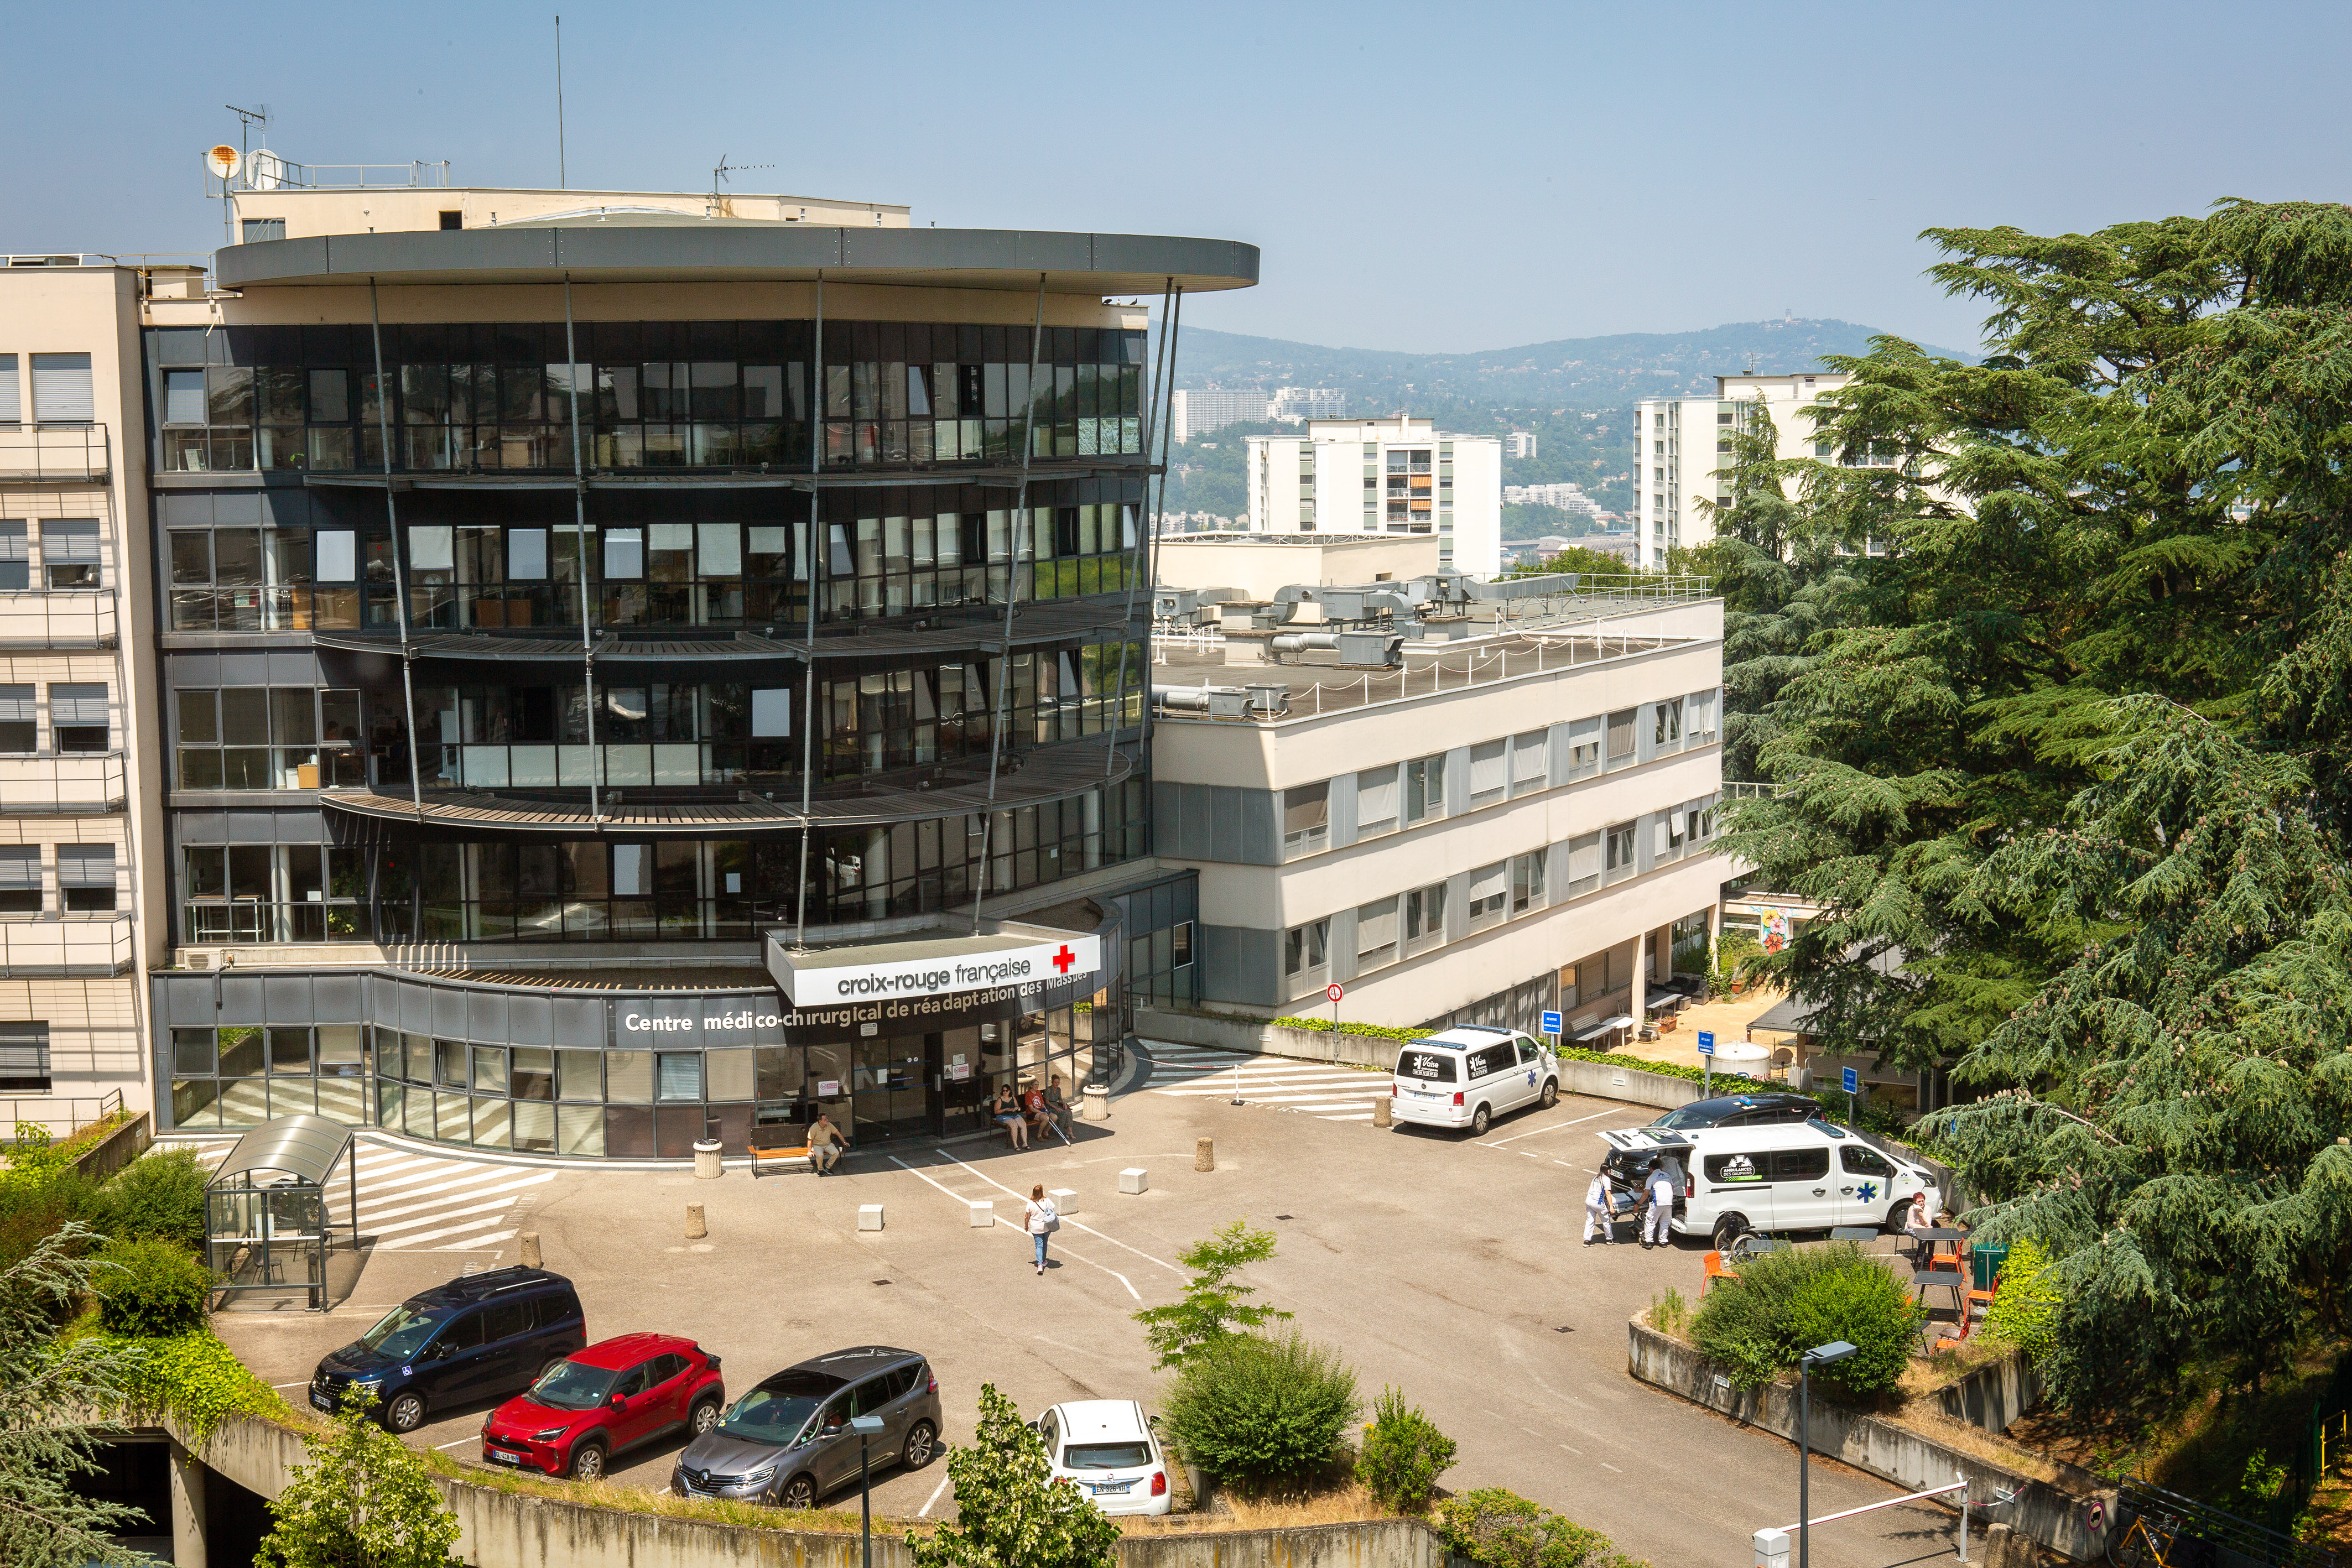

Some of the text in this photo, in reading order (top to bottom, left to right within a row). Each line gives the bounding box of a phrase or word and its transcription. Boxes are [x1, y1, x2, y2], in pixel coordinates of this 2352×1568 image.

[838, 958, 1031, 996] croix-rouge française
[625, 1013, 693, 1032] Centre
[887, 1001, 909, 1018] de
[914, 986, 1016, 1015] réadaptation
[1020, 981, 1042, 997] des
[1422, 1056, 1439, 1069] Vaise
[1474, 1054, 1486, 1067] Vaise
[1205, 1096, 1300, 1113] POPIERS
[1096, 1484, 1126, 1493] EN-326-VH
